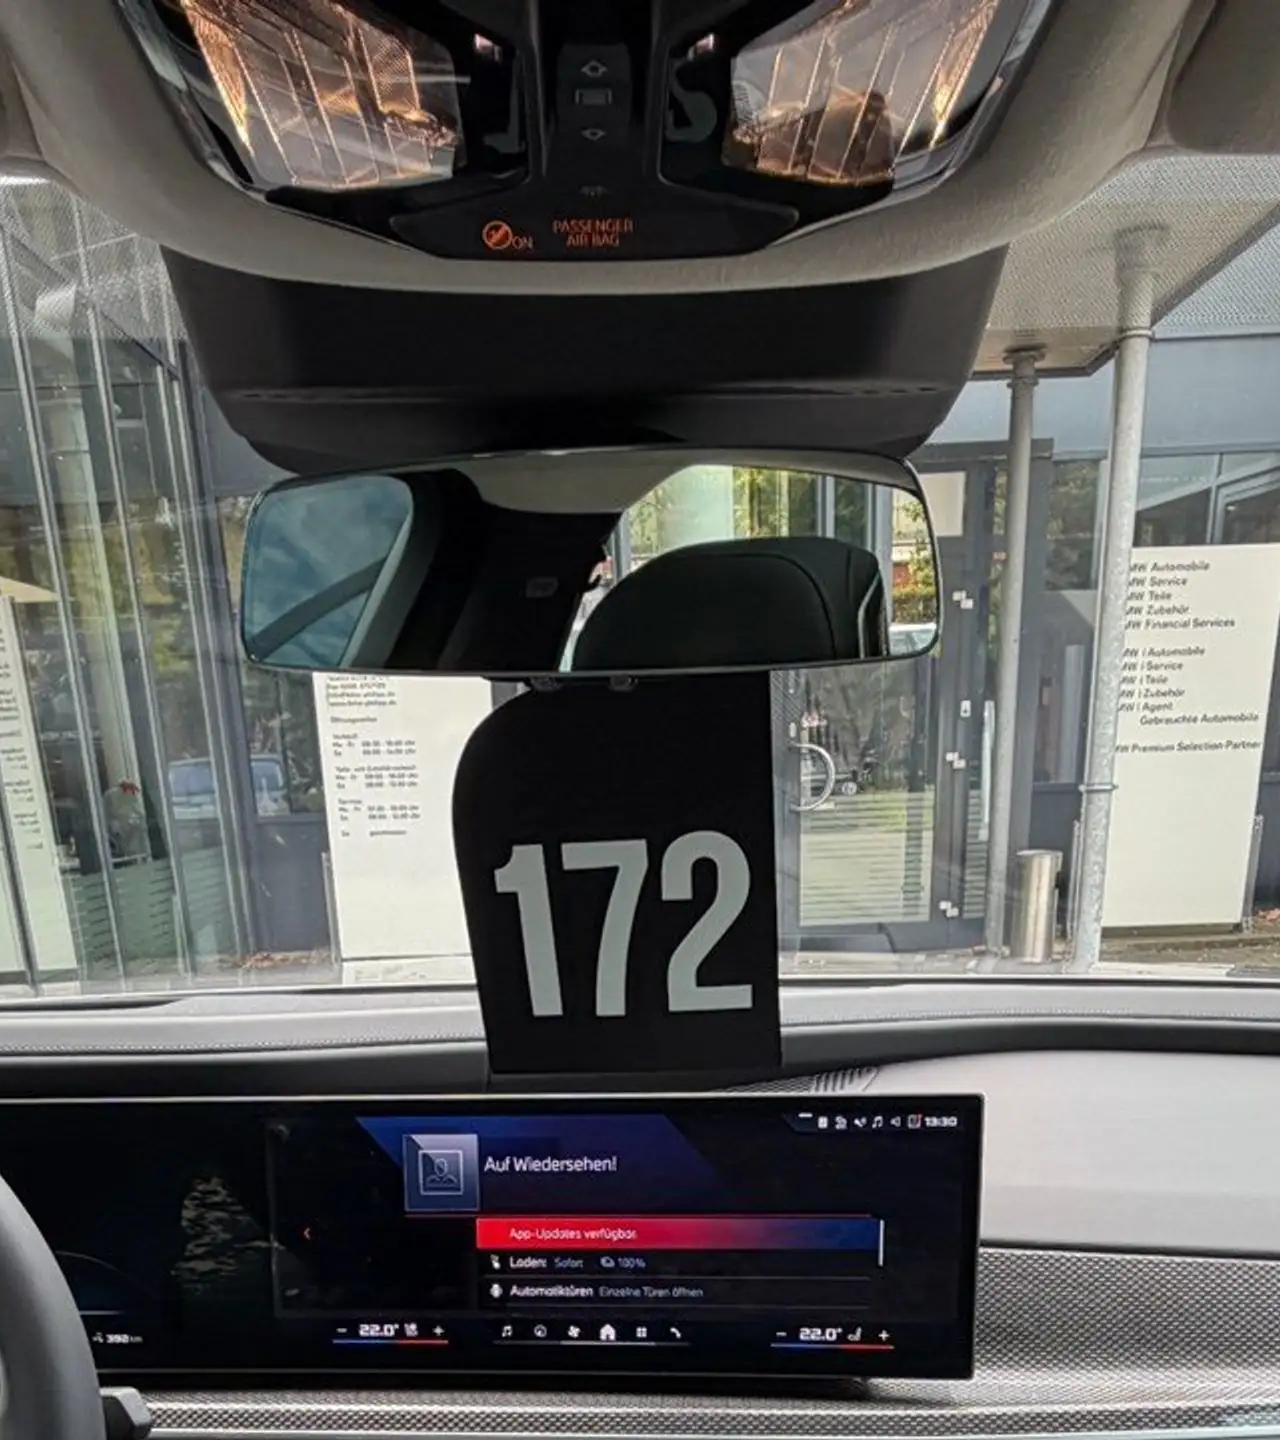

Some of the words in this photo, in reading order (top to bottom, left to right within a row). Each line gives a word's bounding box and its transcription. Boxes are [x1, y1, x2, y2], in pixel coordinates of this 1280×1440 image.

[552, 219, 634, 233] PASSENGER
[512, 235, 533, 250] ON
[1150, 560, 1210, 572] Automobile
[1149, 576, 1188, 587] Service
[1148, 590, 1172, 601] Teile
[1146, 604, 1190, 616] Zubehör
[1144, 617, 1191, 629] Financial
[1192, 616, 1236, 628] Services
[1147, 646, 1205, 657] Automobile
[1146, 660, 1183, 671] Service
[1145, 674, 1169, 684] Teile
[1143, 688, 1185, 698] Zubehör
[1142, 702, 1174, 714] Agent
[1139, 714, 1199, 726] Gebrauchte
[1200, 712, 1260, 724] Automobile
[1131, 743, 1175, 753] Premium
[493, 830, 753, 1018] 172
[924, 1116, 958, 1127] 13:30
[484, 1156, 511, 1172] Auf
[514, 1156, 617, 1172] Wiedersehen!
[509, 1229, 582, 1241] App-Updates
[584, 1228, 637, 1242] verfügbar
[509, 1256, 548, 1268] Laden:
[618, 1257, 646, 1268] 100%
[510, 1285, 594, 1297] Automatiktüren
[599, 1286, 641, 1297] Einzelne
[643, 1286, 671, 1297] Türen
[671, 1287, 704, 1297] öffnen
[359, 1323, 400, 1337] 22.0°
[799, 1327, 843, 1341] 22.0°
